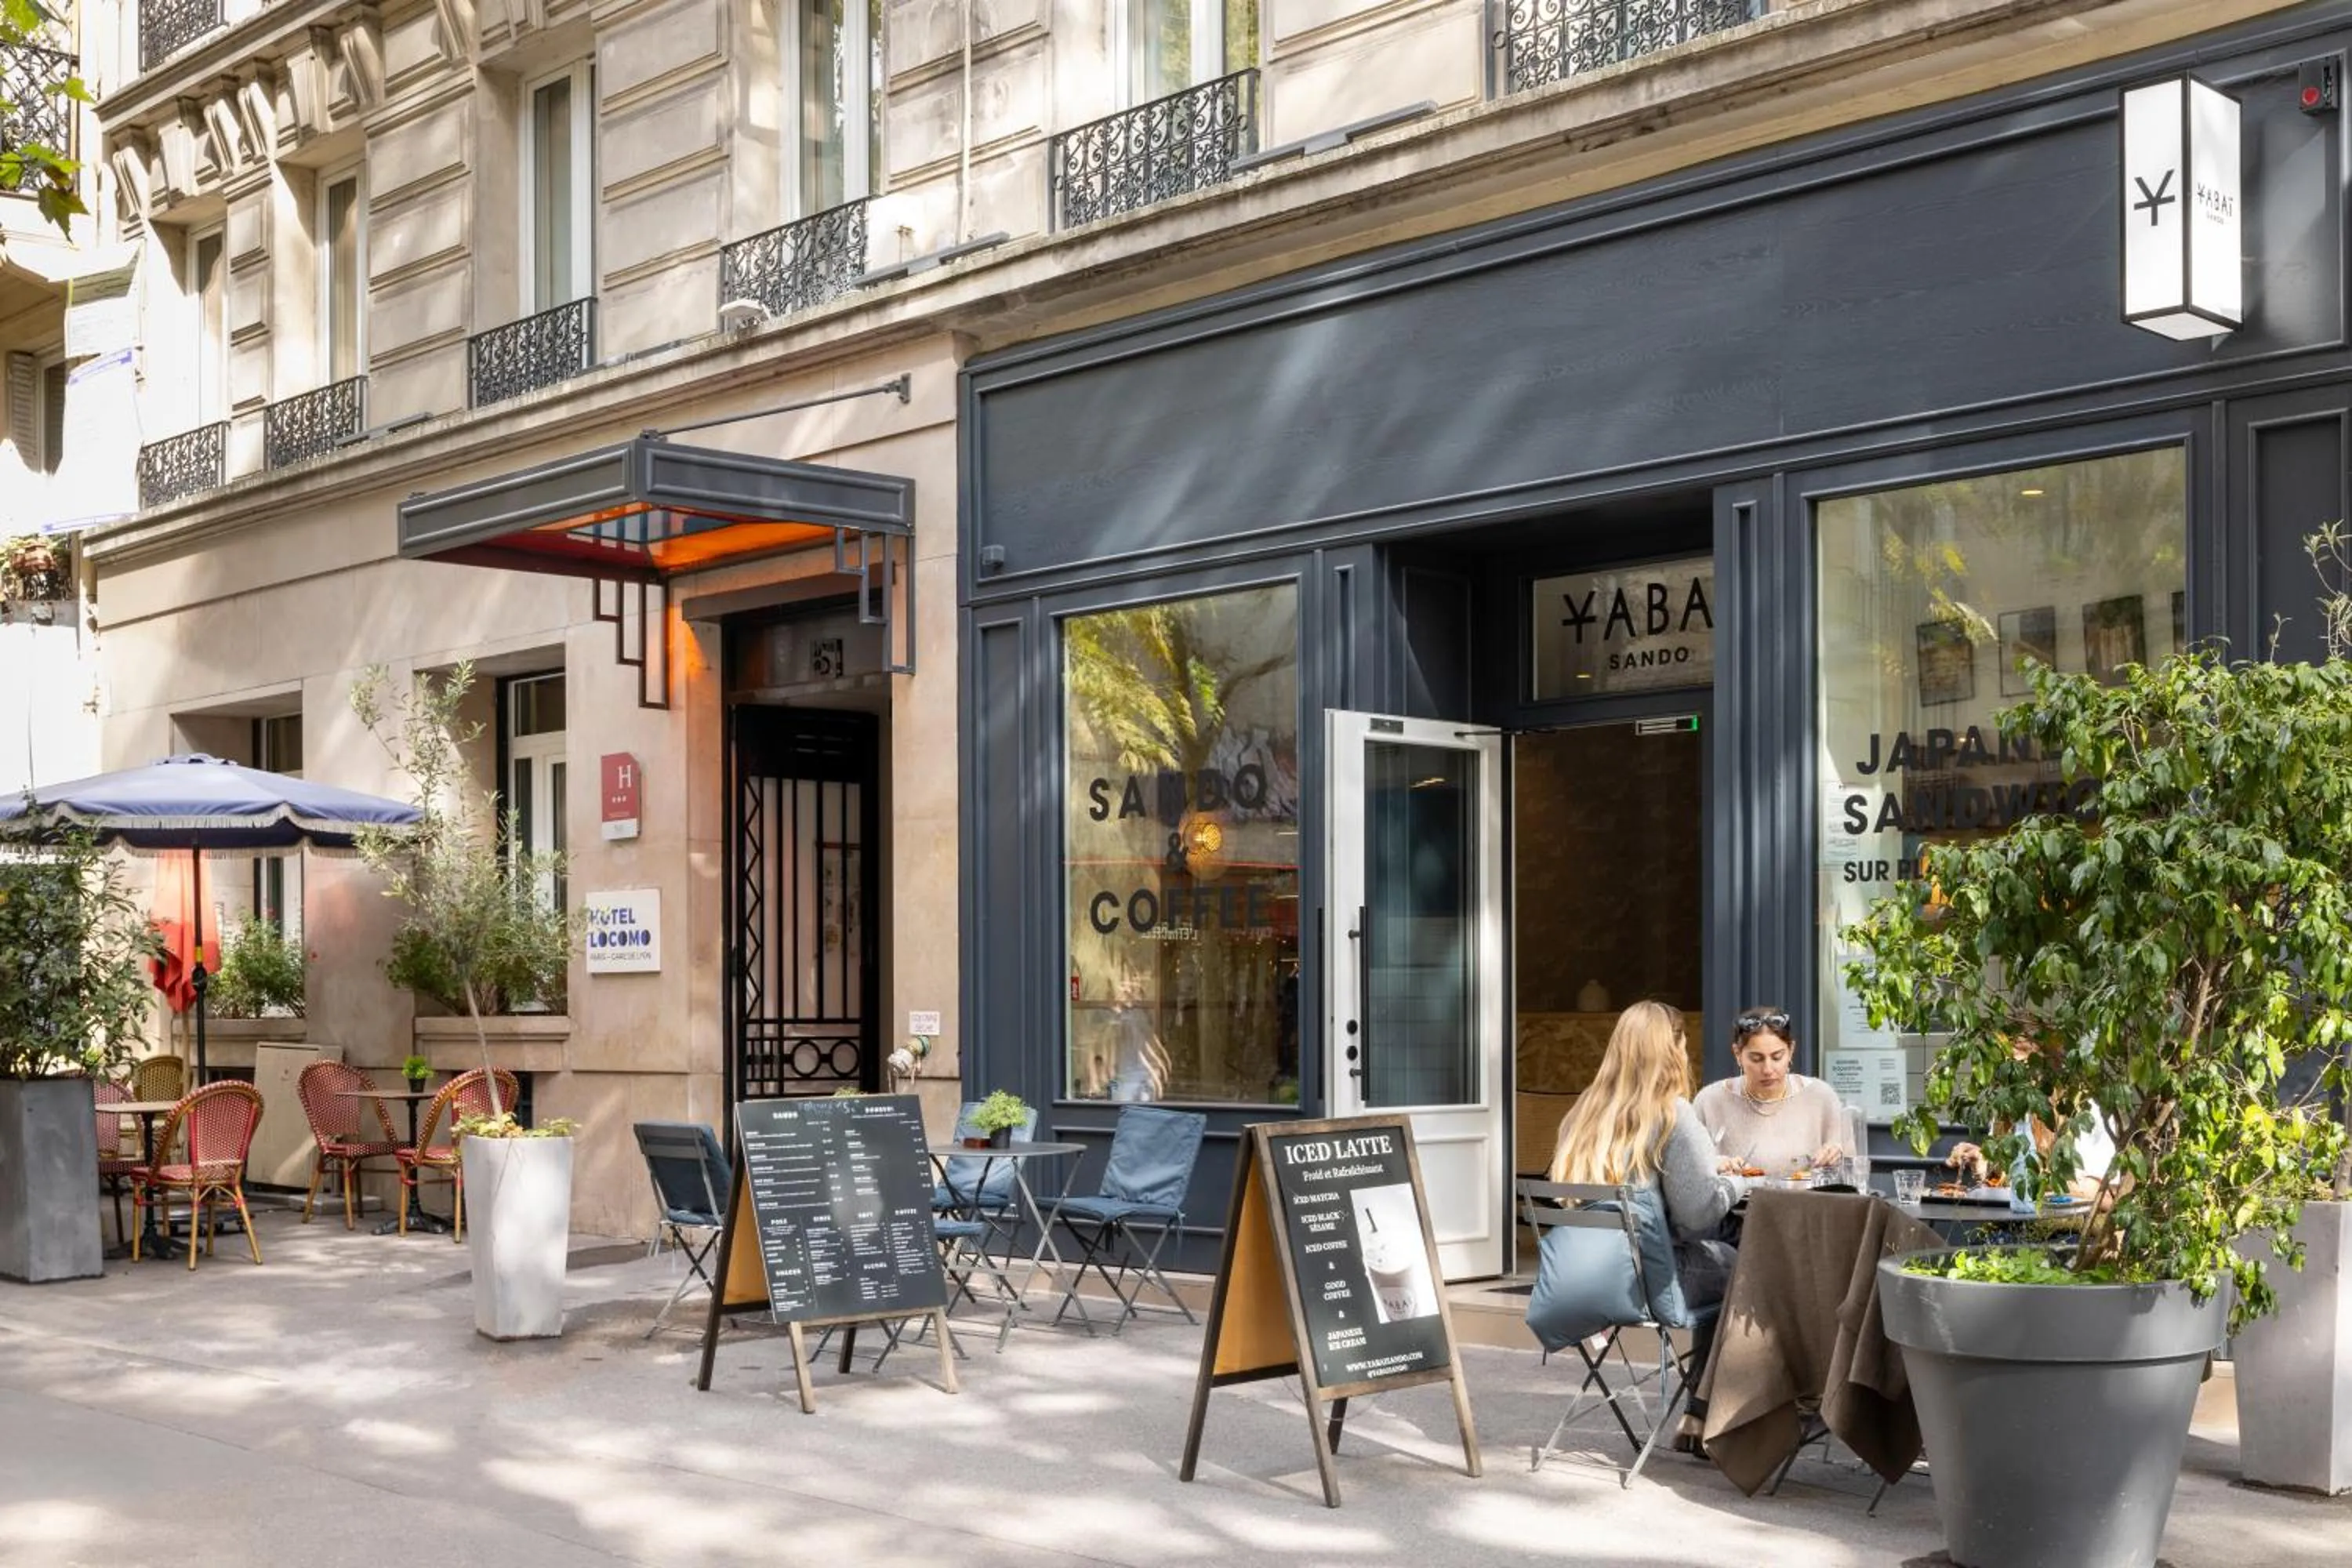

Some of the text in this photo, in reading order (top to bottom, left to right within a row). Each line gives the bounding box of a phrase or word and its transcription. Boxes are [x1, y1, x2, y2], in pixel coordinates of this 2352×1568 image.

[1609, 647, 1690, 670] SANDO
[618, 764, 632, 789] H
[1089, 764, 1268, 822] SANDO
[1842, 778, 2103, 835] SANDWIC
[1843, 858, 1924, 882] SUR PL
[1091, 885, 1269, 934] COFFEE
[590, 929, 652, 948] LOCOMO
[1284, 1135, 1393, 1164] ICED LATTE
[1293, 1192, 1340, 1205] ICED MATCHA
[1301, 1211, 1341, 1224] ICED BLACK
[1305, 1243, 1322, 1254] ICED
[1324, 1279, 1347, 1290] GOOD
[1323, 1290, 1352, 1301] COFFEE
[1327, 1327, 1364, 1341] JAPANESE
[1341, 1337, 1367, 1348] CREAM
